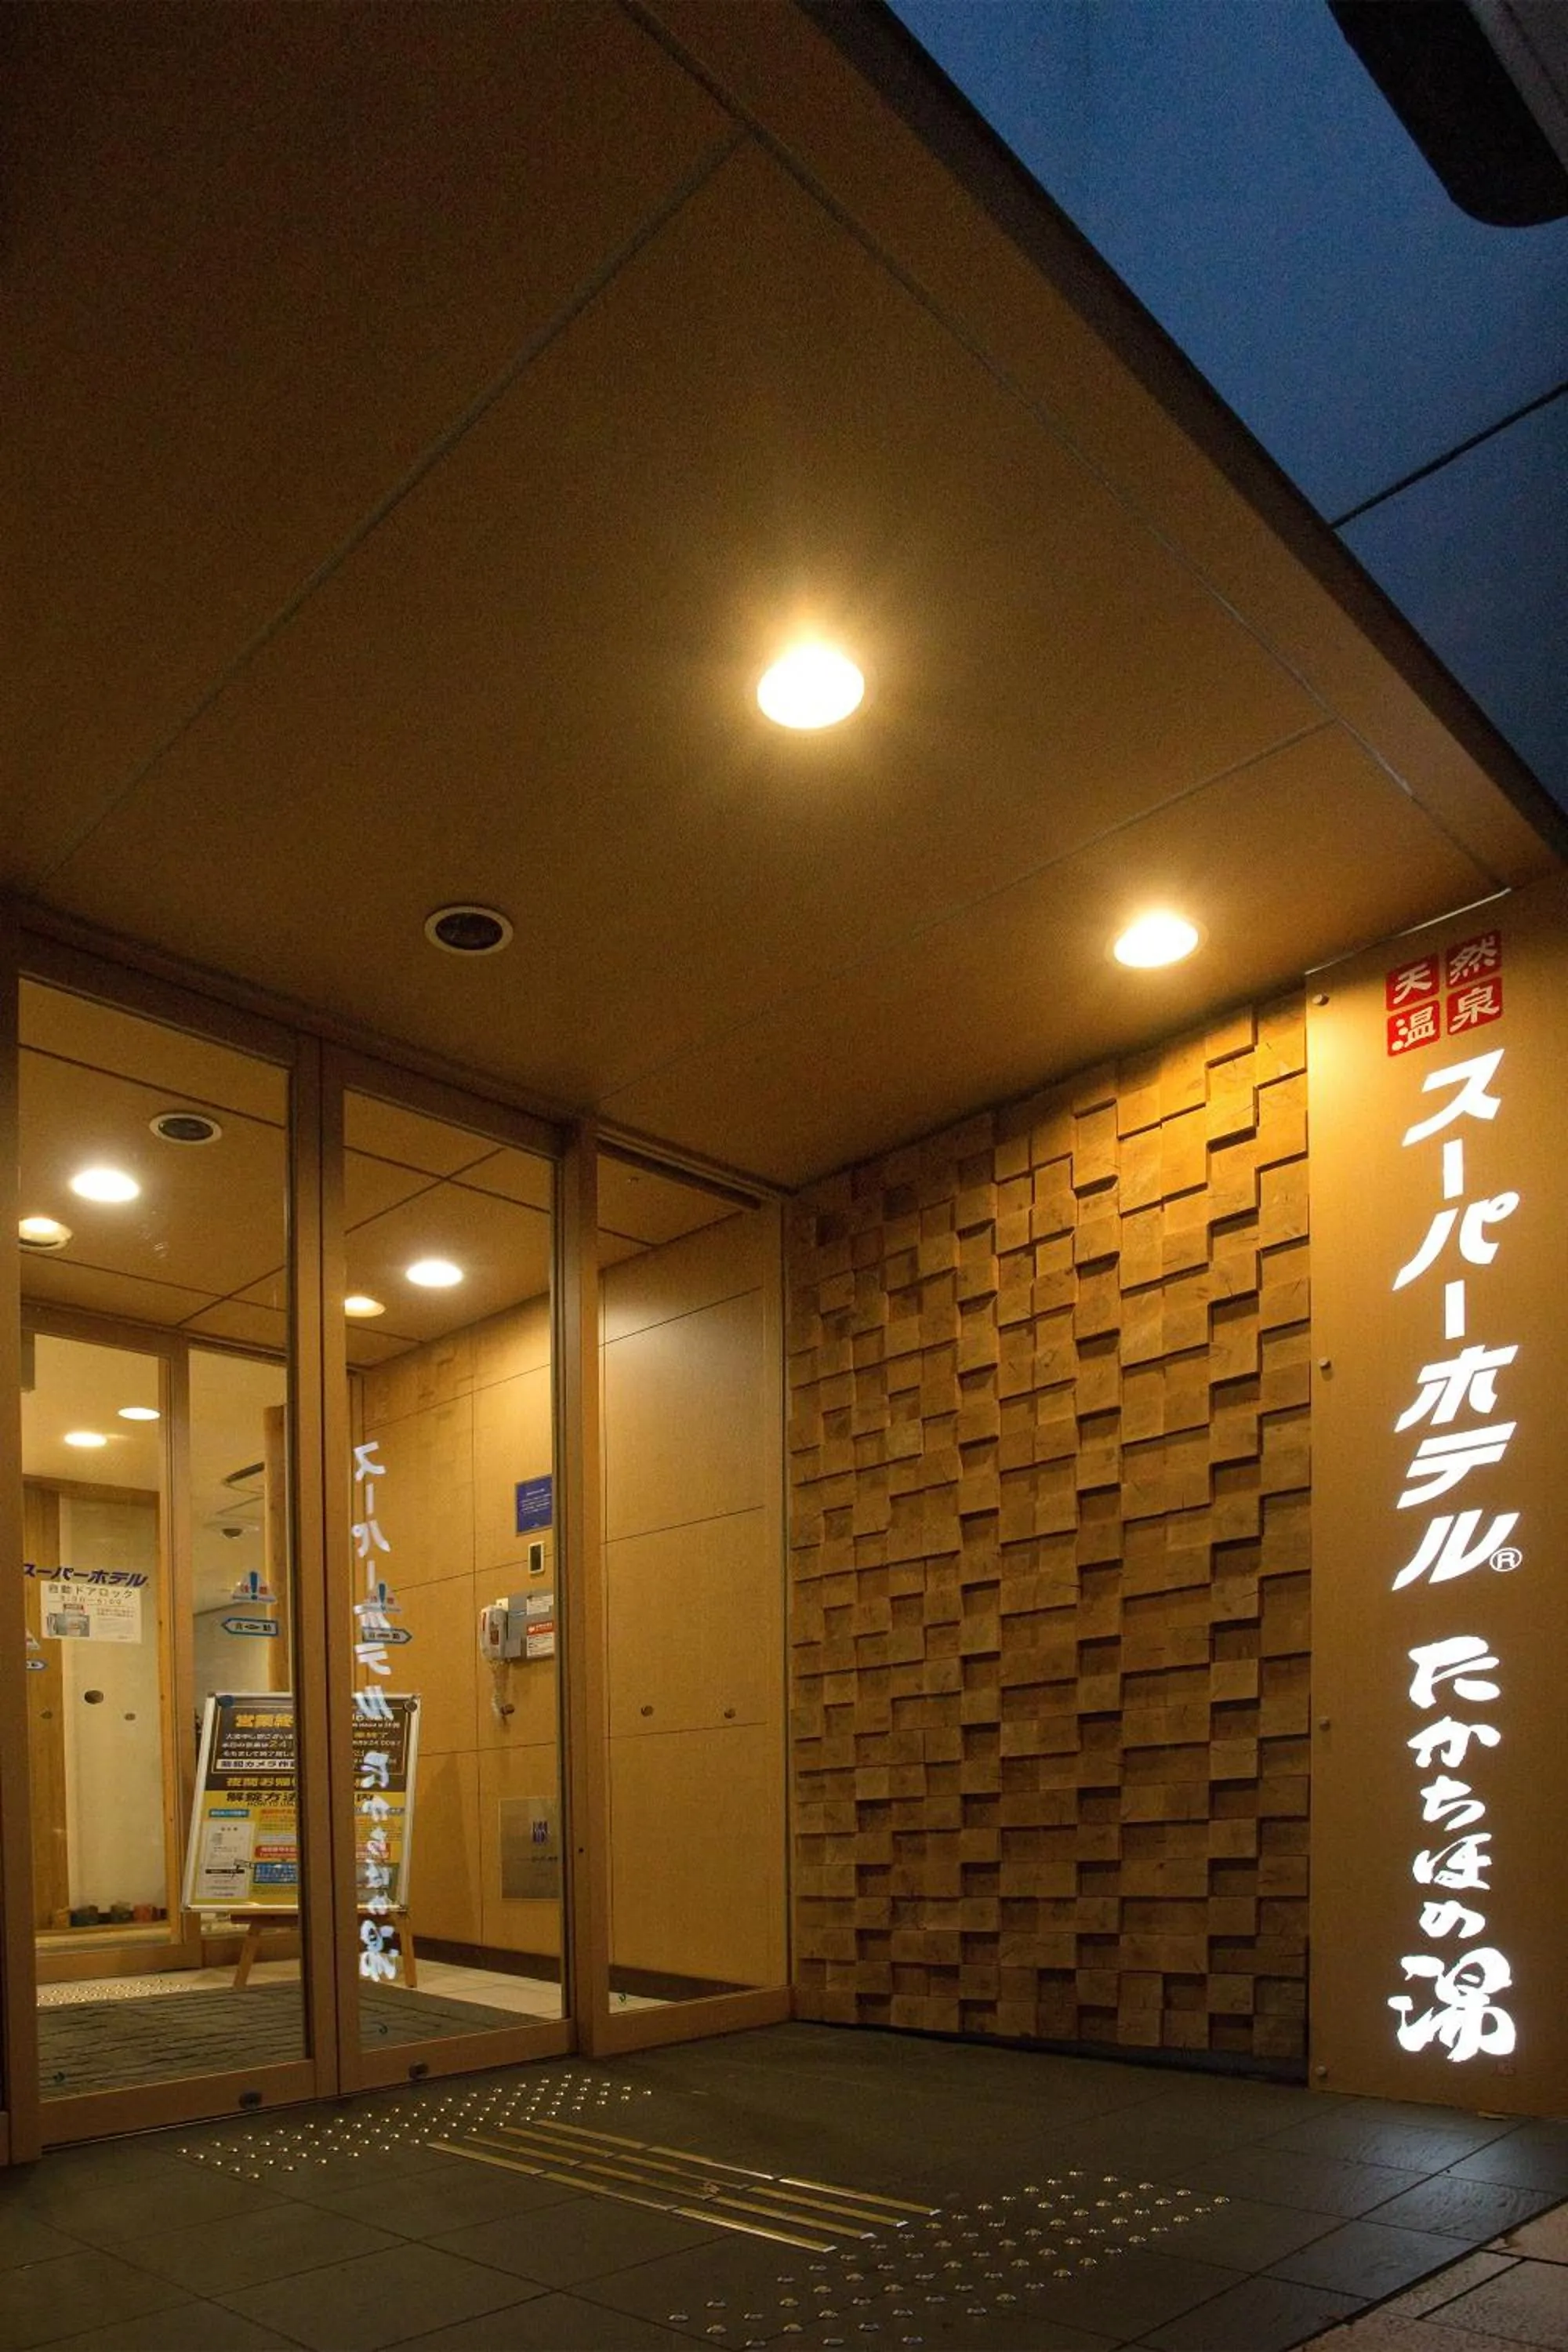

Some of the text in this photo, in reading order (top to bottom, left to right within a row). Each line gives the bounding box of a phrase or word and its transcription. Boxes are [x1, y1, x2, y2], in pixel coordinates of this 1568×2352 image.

[1393, 935, 1497, 1004] 天然
[1392, 985, 1500, 1051] 温泉
[24, 1564, 148, 1587] スーパーホテル
[1388, 1636, 1517, 2062] たかちほの湯
